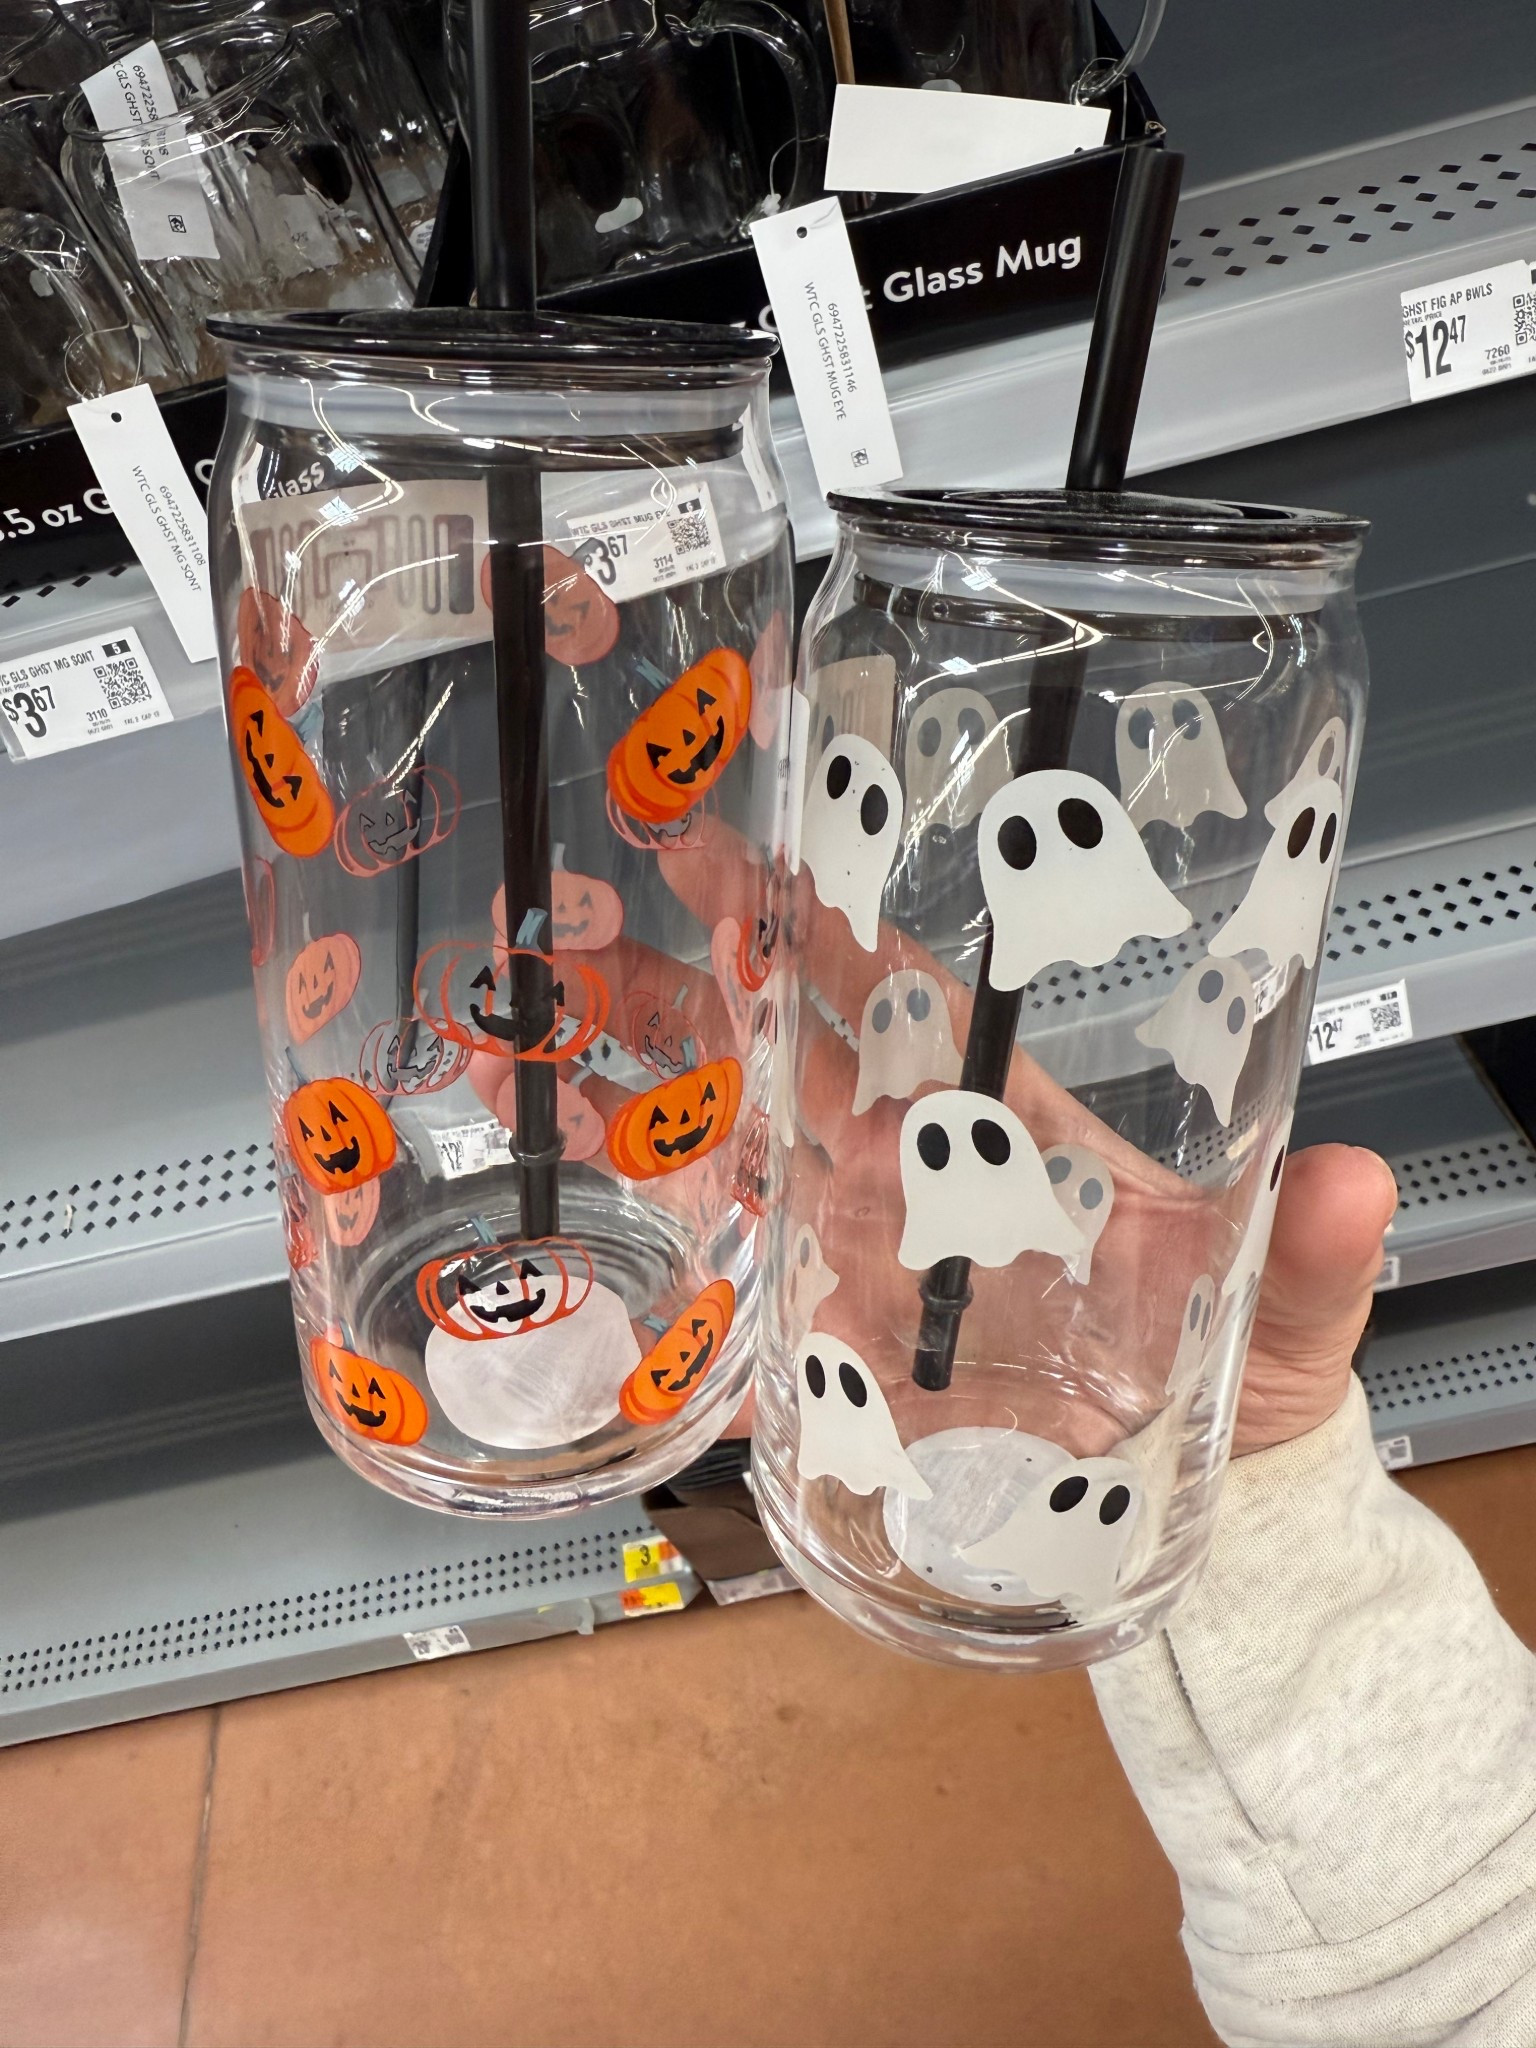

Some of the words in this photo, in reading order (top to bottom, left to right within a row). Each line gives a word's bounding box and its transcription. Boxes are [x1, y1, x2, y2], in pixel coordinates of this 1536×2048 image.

[116, 70, 132, 90] GLS
[125, 92, 143, 124] GHST
[883, 262, 983, 302] Glass
[996, 236, 1081, 278] Mug
[805, 282, 820, 311] WTC
[1402, 301, 1428, 318] GHST
[1431, 296, 1447, 311] FIG
[1450, 291, 1463, 306] AP
[1466, 283, 1493, 301] BWLS
[812, 312, 826, 336] GLS
[818, 336, 834, 369] GHST
[828, 303, 857, 393] 6947225831146
[1485, 344, 1510, 360] 7260
[826, 371, 842, 399] MUG
[834, 400, 846, 421] EYE
[0, 508, 35, 541] .5
[42, 504, 82, 527] oz
[132, 465, 150, 492] WTC
[145, 493, 162, 515] GLS
[156, 515, 177, 548] GHST
[171, 545, 186, 565] MG
[160, 485, 206, 566] 6947225831108
[10, 669, 28, 684] GLS
[28, 662, 53, 678] GHST
[53, 657, 70, 671] MG
[86, 708, 108, 722] 3110
[639, 1545, 651, 1566] 3
